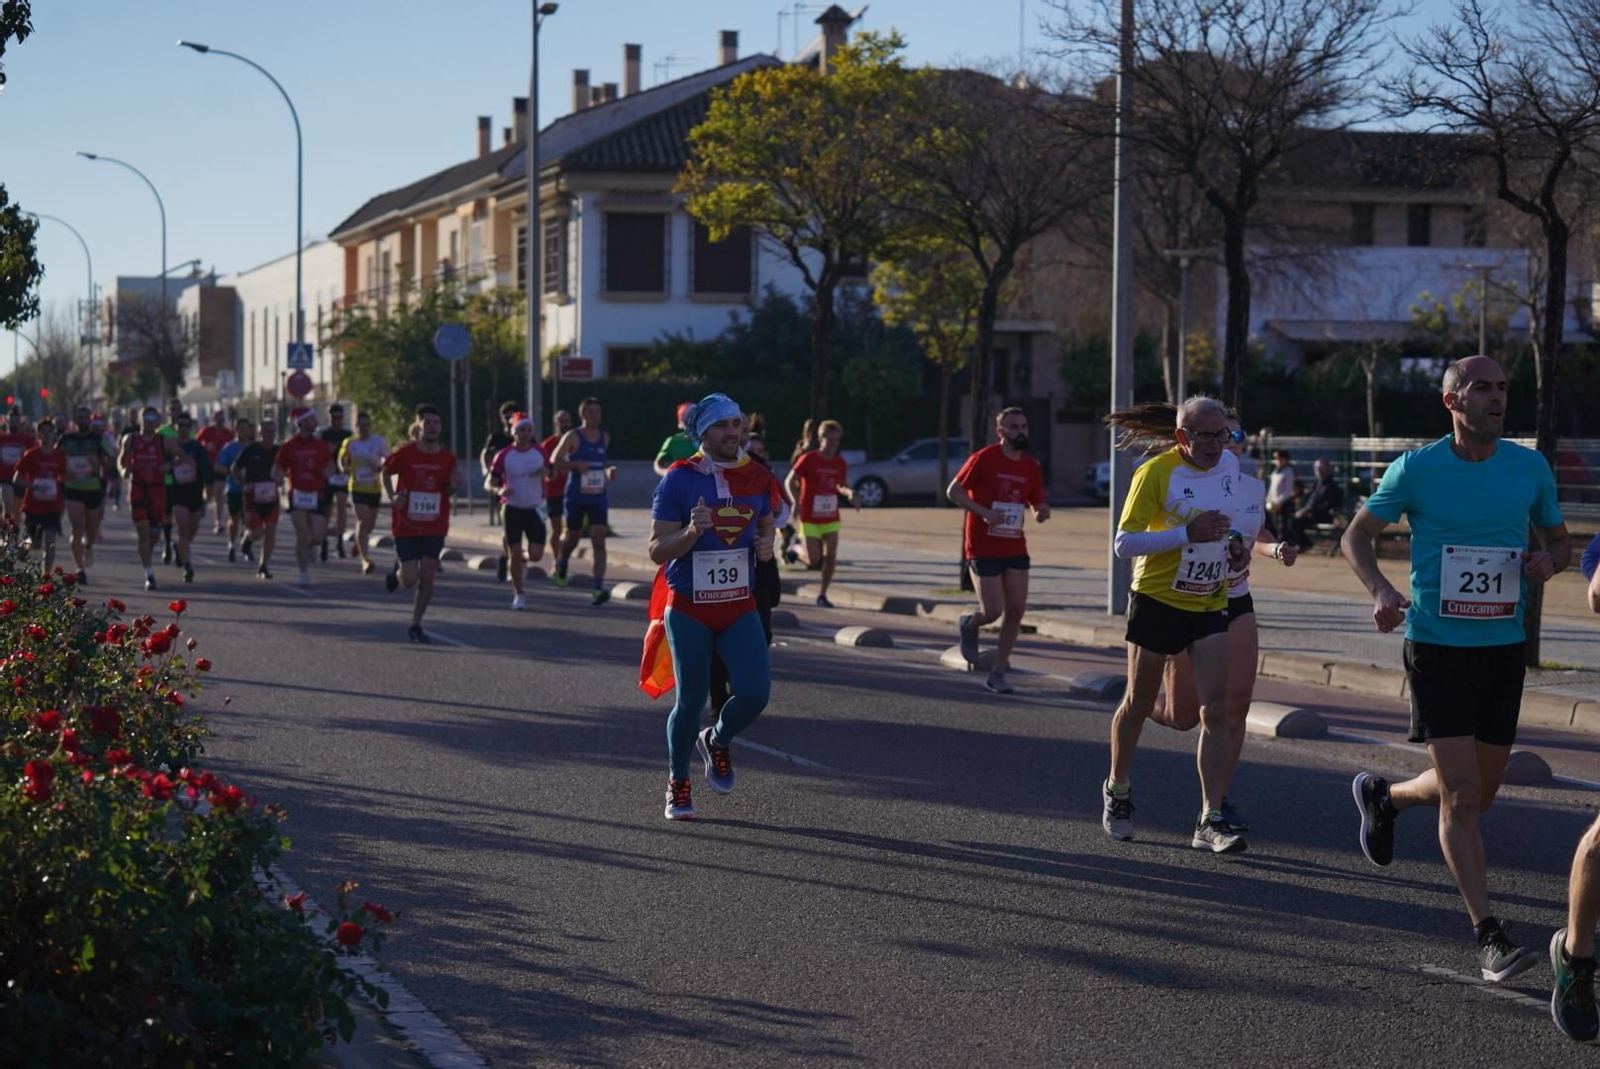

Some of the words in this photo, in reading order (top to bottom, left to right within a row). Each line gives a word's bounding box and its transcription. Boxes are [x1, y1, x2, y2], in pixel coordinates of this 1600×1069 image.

[414, 501, 437, 512] 1194
[707, 567, 739, 585] 139
[1186, 561, 1222, 580] 1243
[1458, 571, 1503, 595] 231
[698, 588, 740, 600] Cruzcampo
[1447, 601, 1505, 616] Cruzcampo
